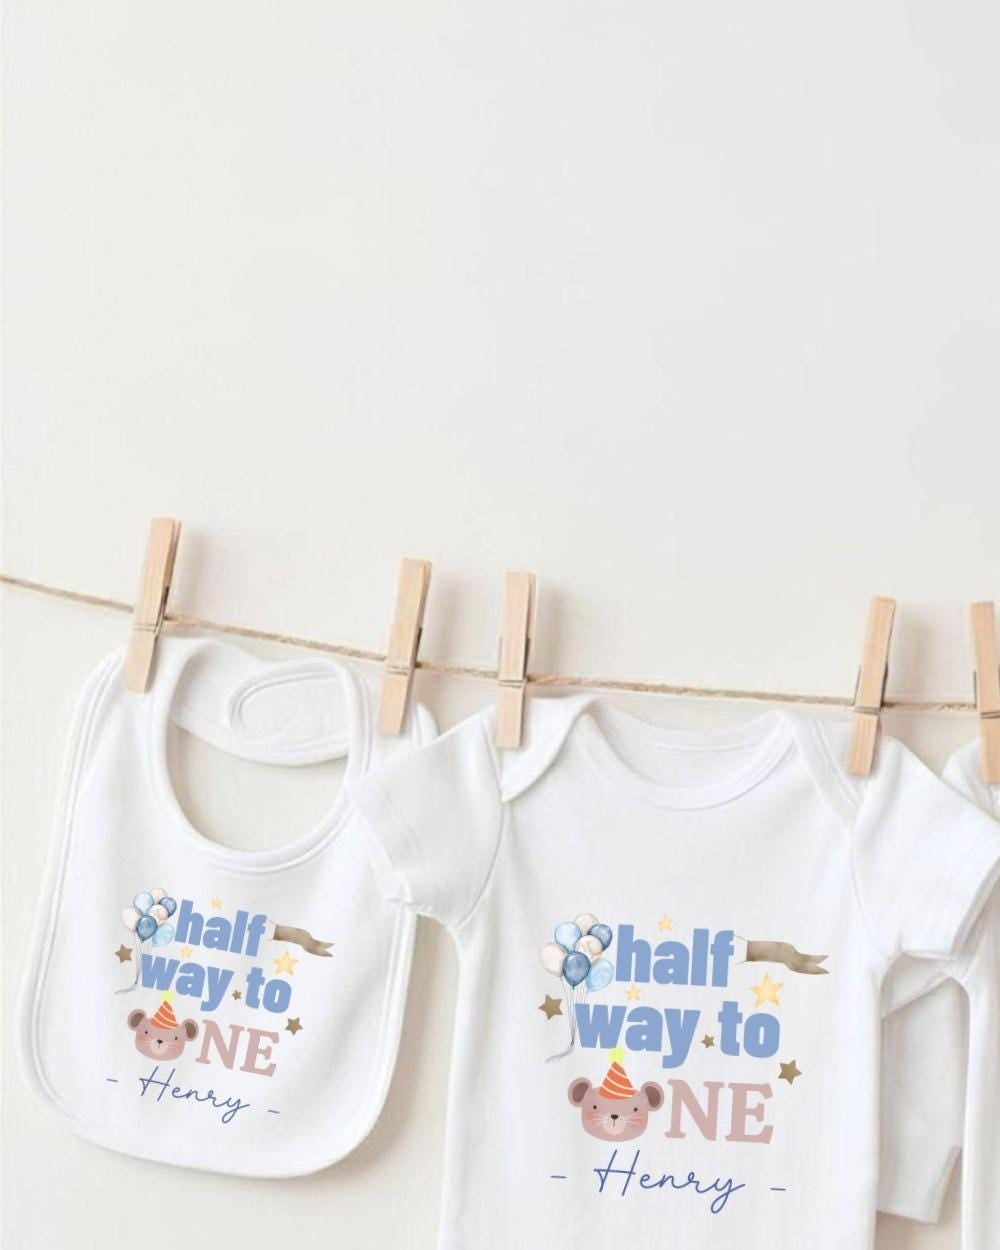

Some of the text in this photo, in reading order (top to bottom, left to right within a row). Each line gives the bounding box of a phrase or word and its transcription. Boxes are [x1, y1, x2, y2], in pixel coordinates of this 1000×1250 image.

[173, 898, 268, 958] half
[615, 923, 735, 988] half
[140, 953, 293, 1015] way to
[574, 1000, 780, 1069] way to
[138, 1065, 251, 1124] Henry
[593, 1149, 746, 1214] Henry
